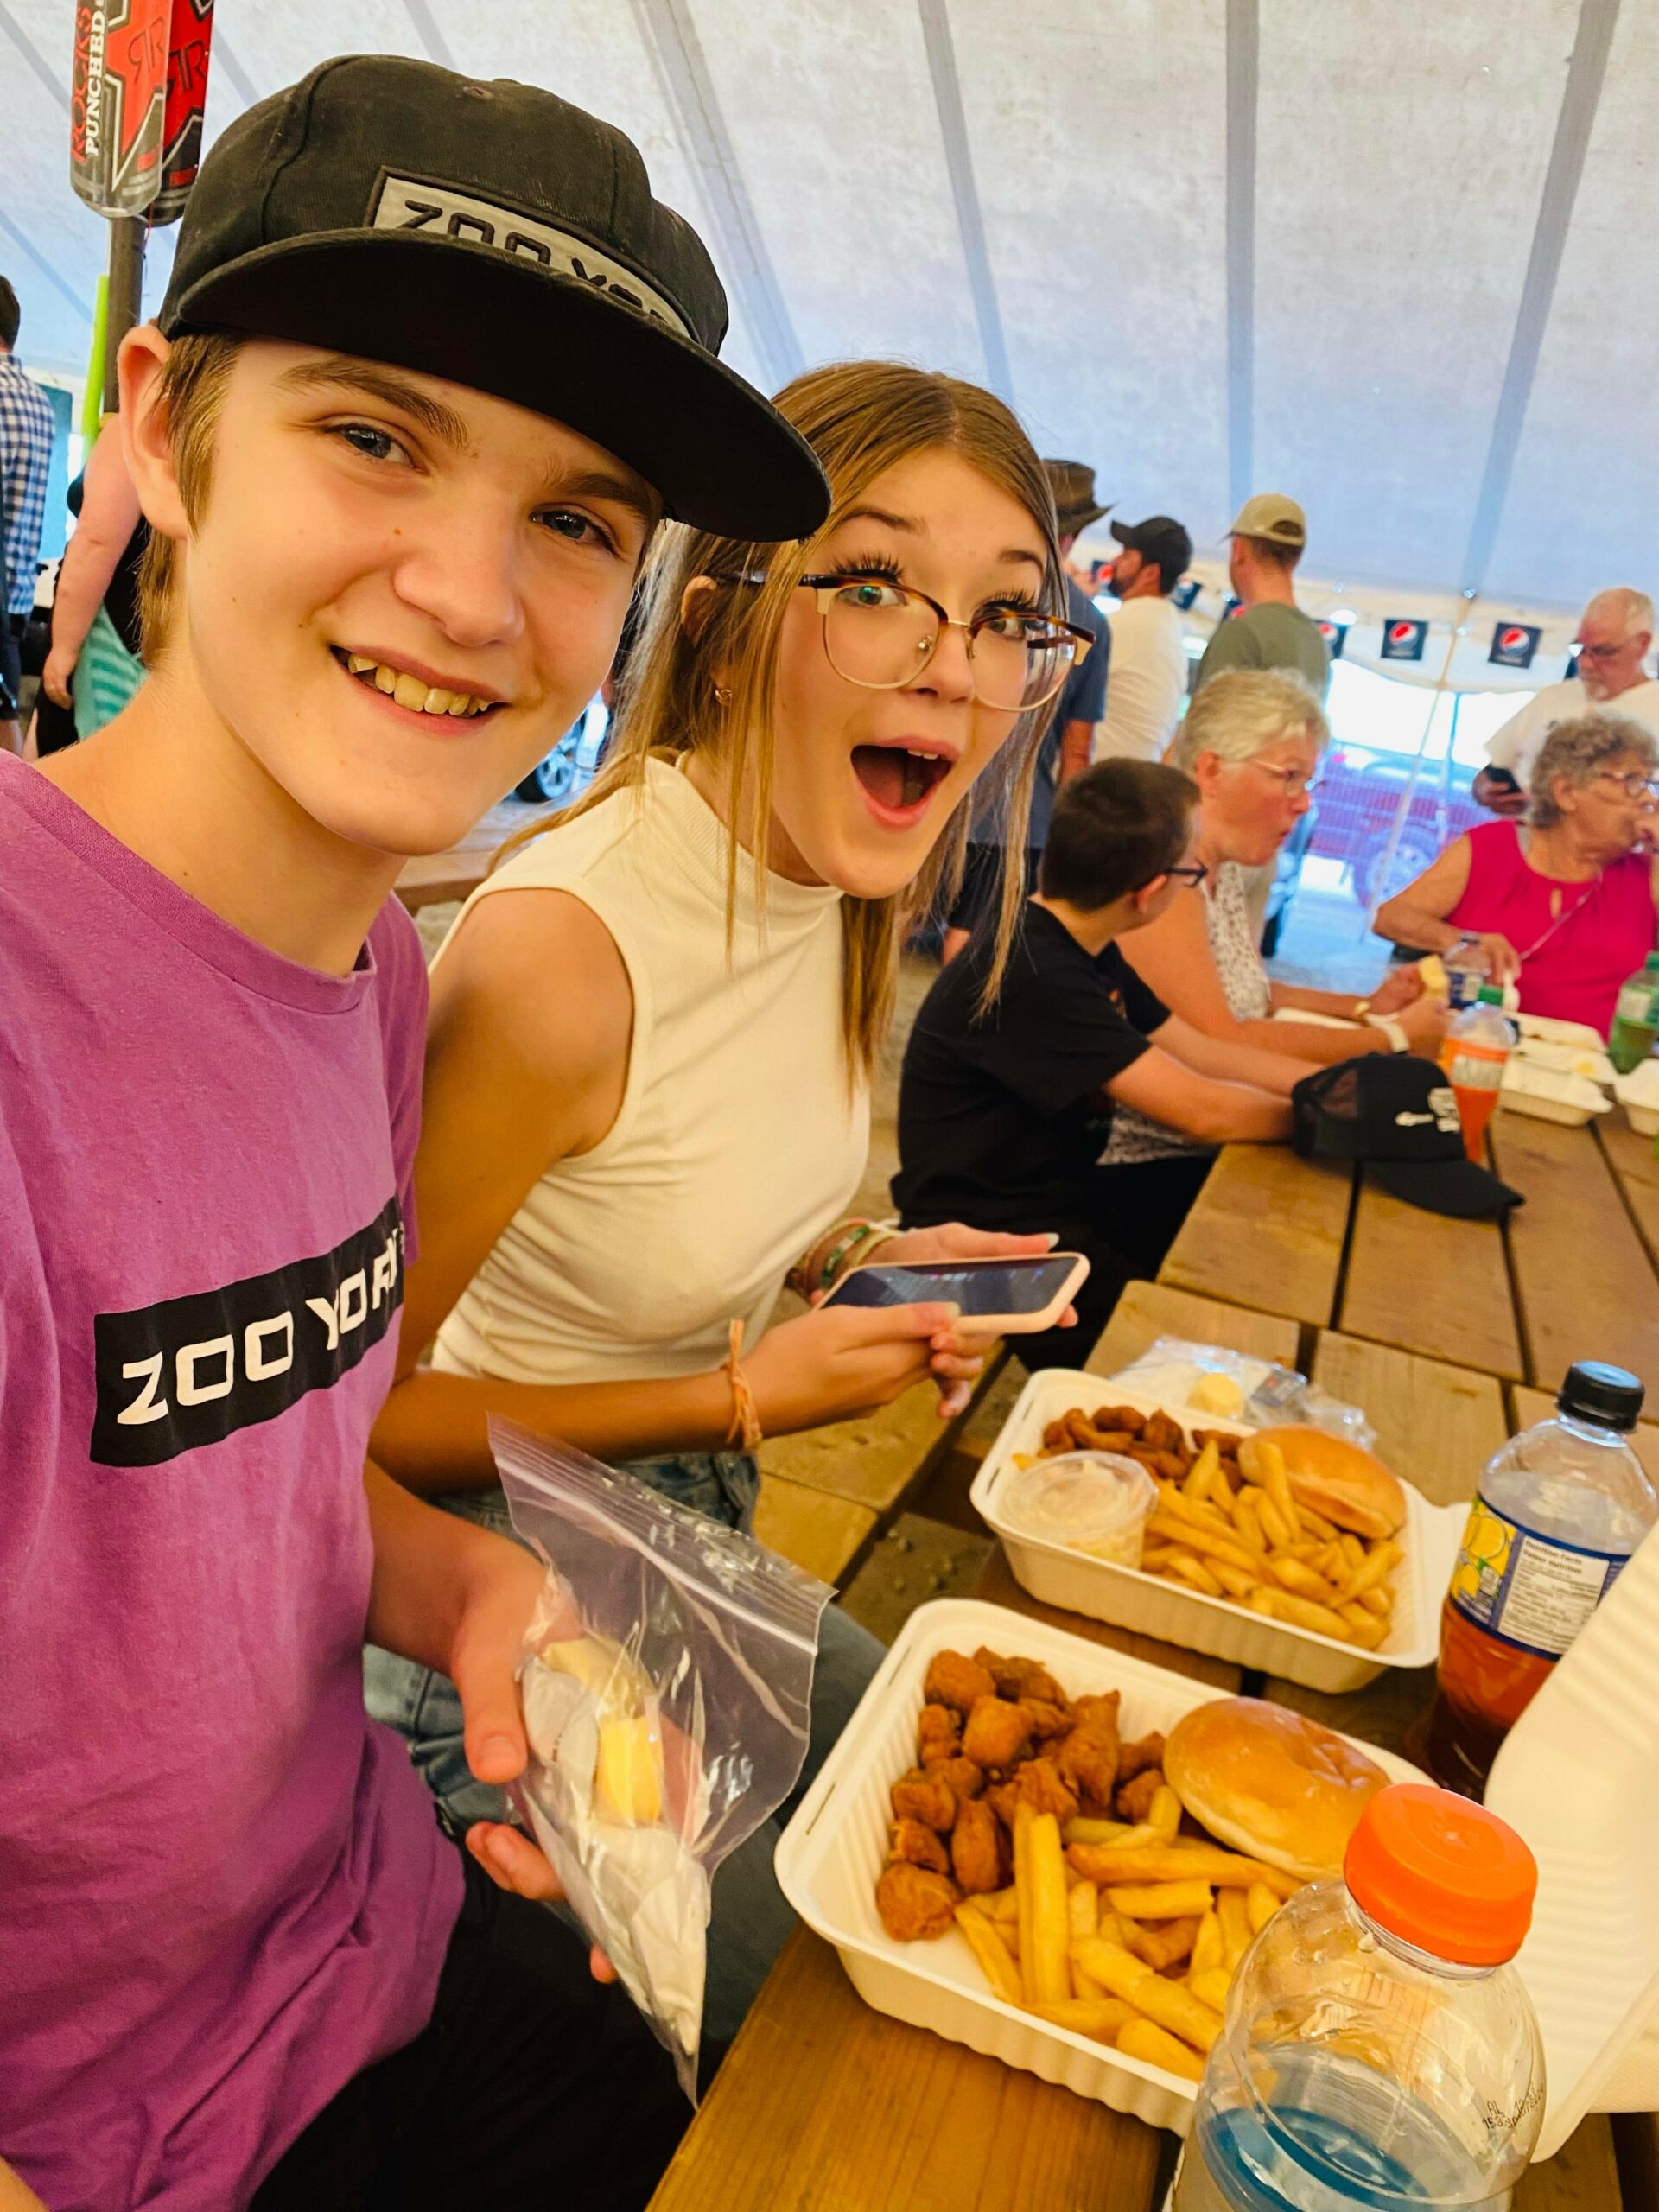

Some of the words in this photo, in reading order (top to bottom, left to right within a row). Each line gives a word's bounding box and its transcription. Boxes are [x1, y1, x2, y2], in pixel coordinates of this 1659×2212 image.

[86, 11, 105, 156] PUNCHED
[117, 1310, 294, 1426] ZOO
[305, 1221, 405, 1351] YOR
